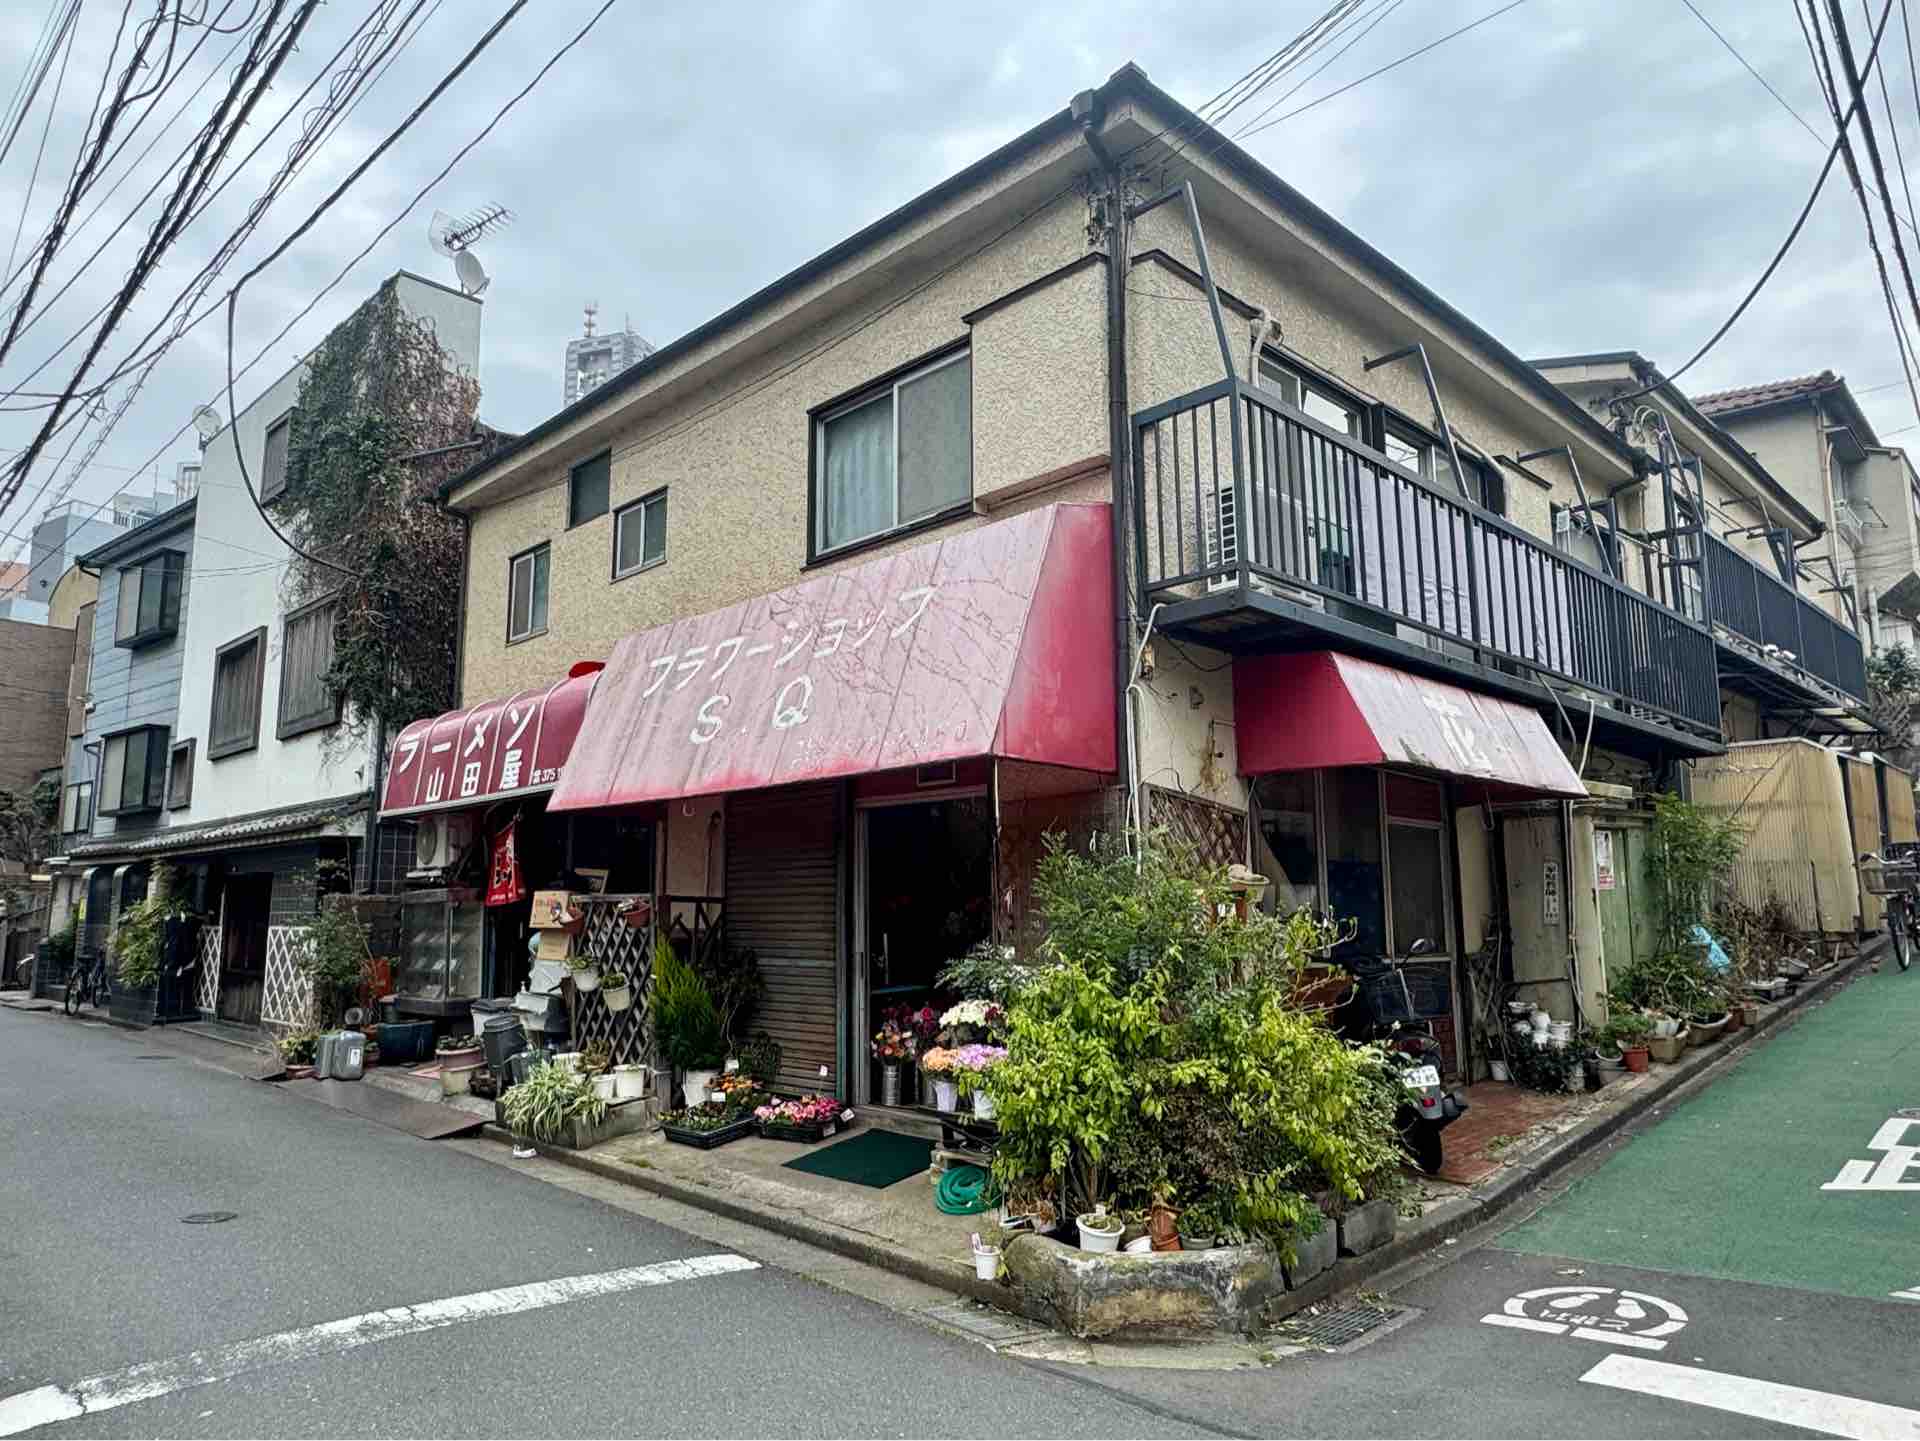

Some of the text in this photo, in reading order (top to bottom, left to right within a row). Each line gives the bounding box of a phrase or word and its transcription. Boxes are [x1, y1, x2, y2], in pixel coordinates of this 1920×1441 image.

[399, 704, 538, 774] ラーメン
[1421, 693, 1493, 771] 花
[425, 749, 523, 803] 山田屋
